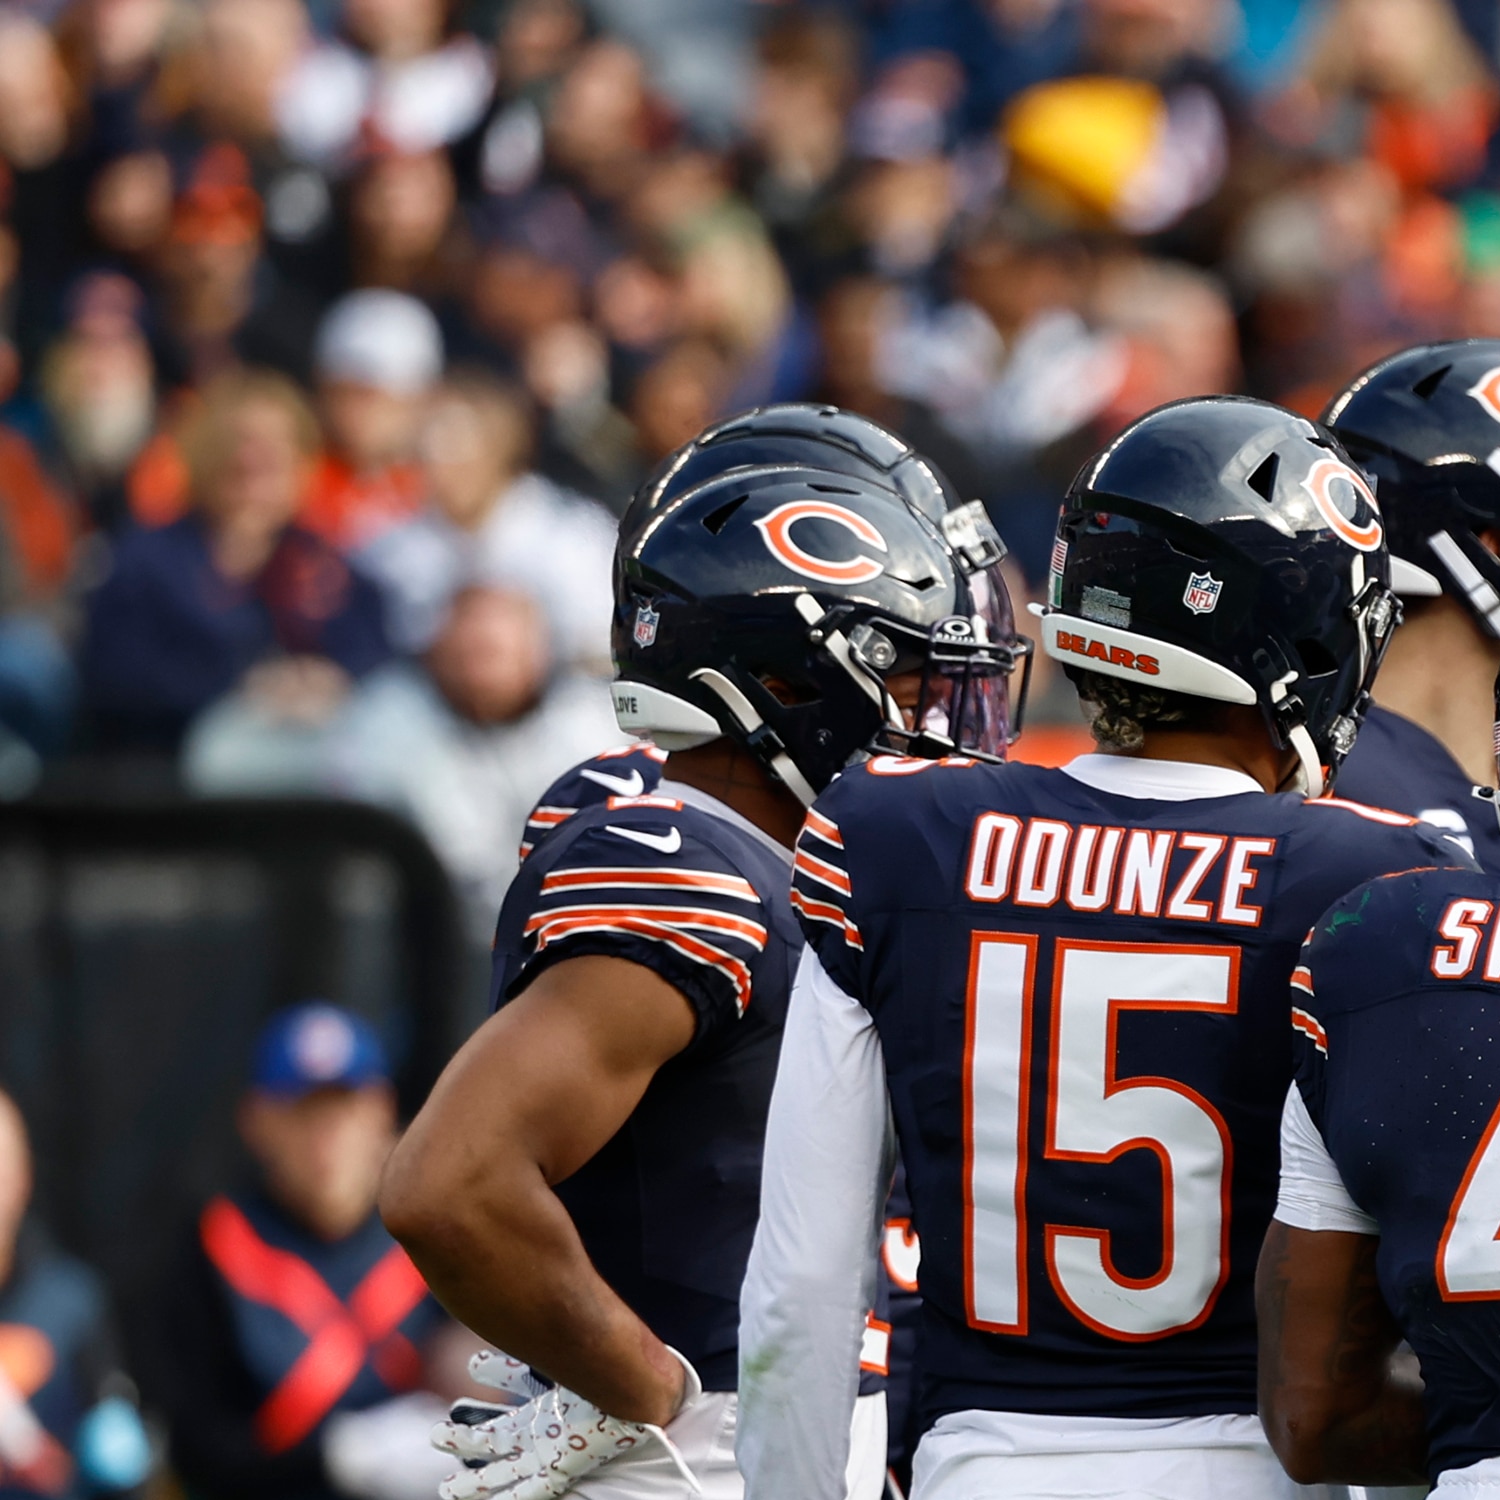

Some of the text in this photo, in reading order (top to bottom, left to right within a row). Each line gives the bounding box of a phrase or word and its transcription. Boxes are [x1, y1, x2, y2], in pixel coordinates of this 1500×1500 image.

[1056, 630, 1160, 676] BEARS
[966, 811, 1276, 926] ODUNZE
[962, 929, 1241, 1342] 15
